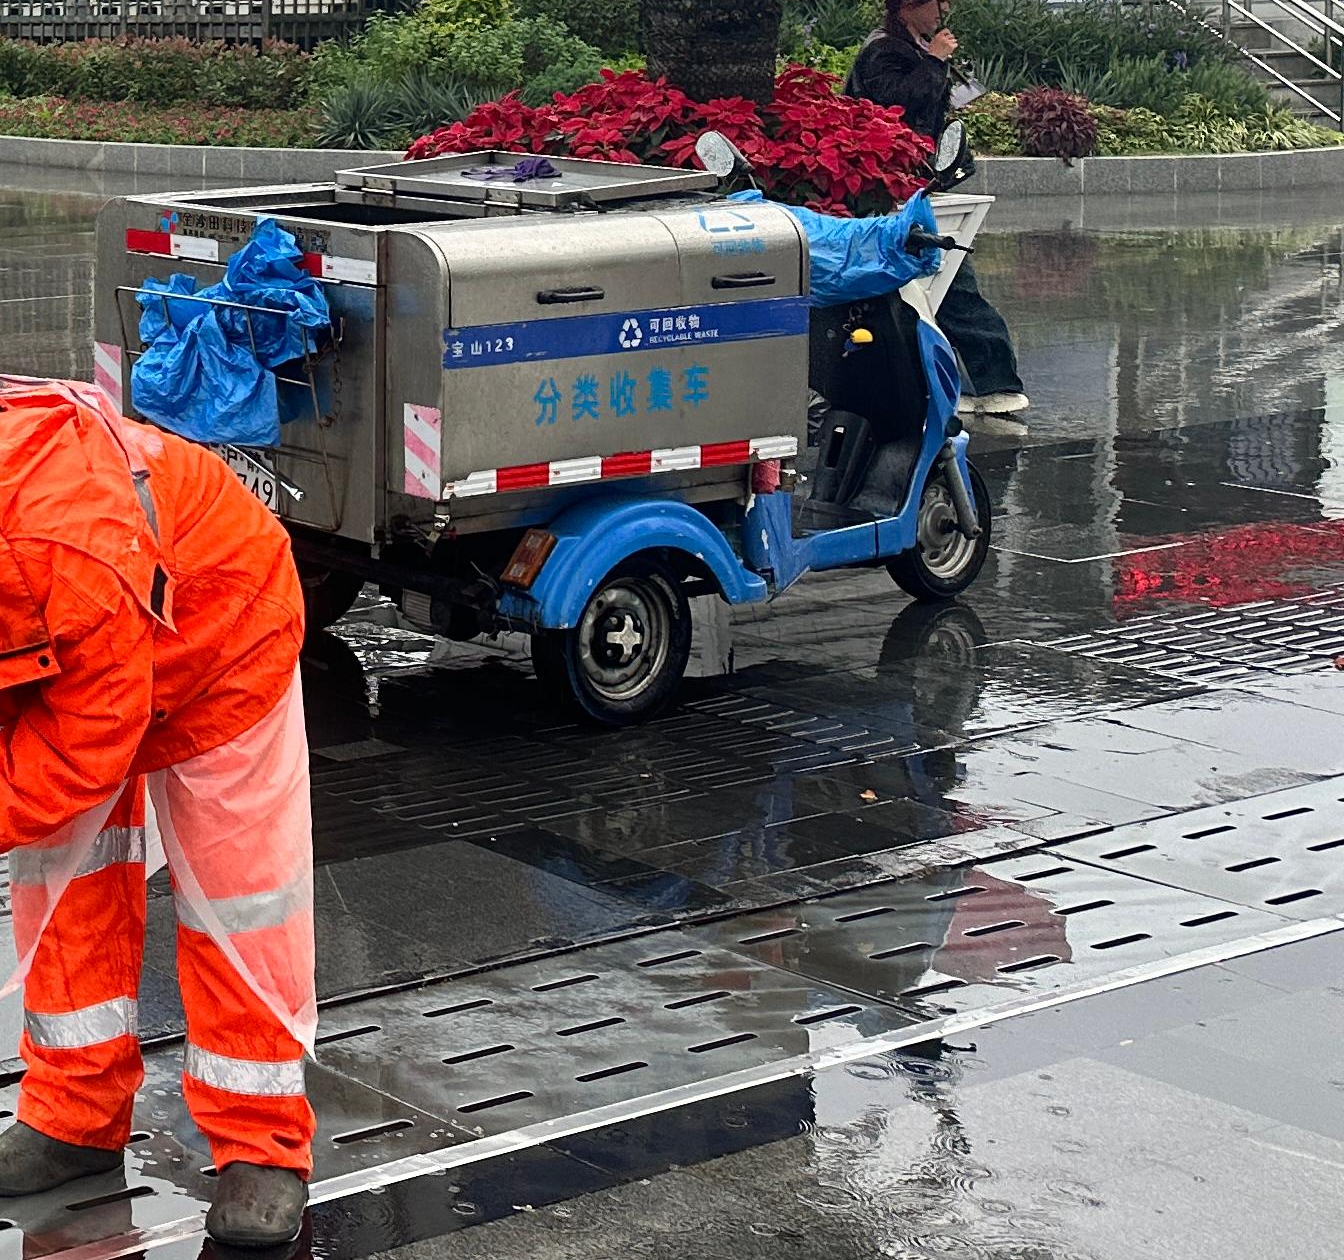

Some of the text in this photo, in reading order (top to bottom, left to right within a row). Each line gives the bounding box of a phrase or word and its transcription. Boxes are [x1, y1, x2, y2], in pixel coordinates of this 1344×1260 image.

[649, 315, 700, 333] 可回收物
[533, 362, 710, 426] 分类收集车
